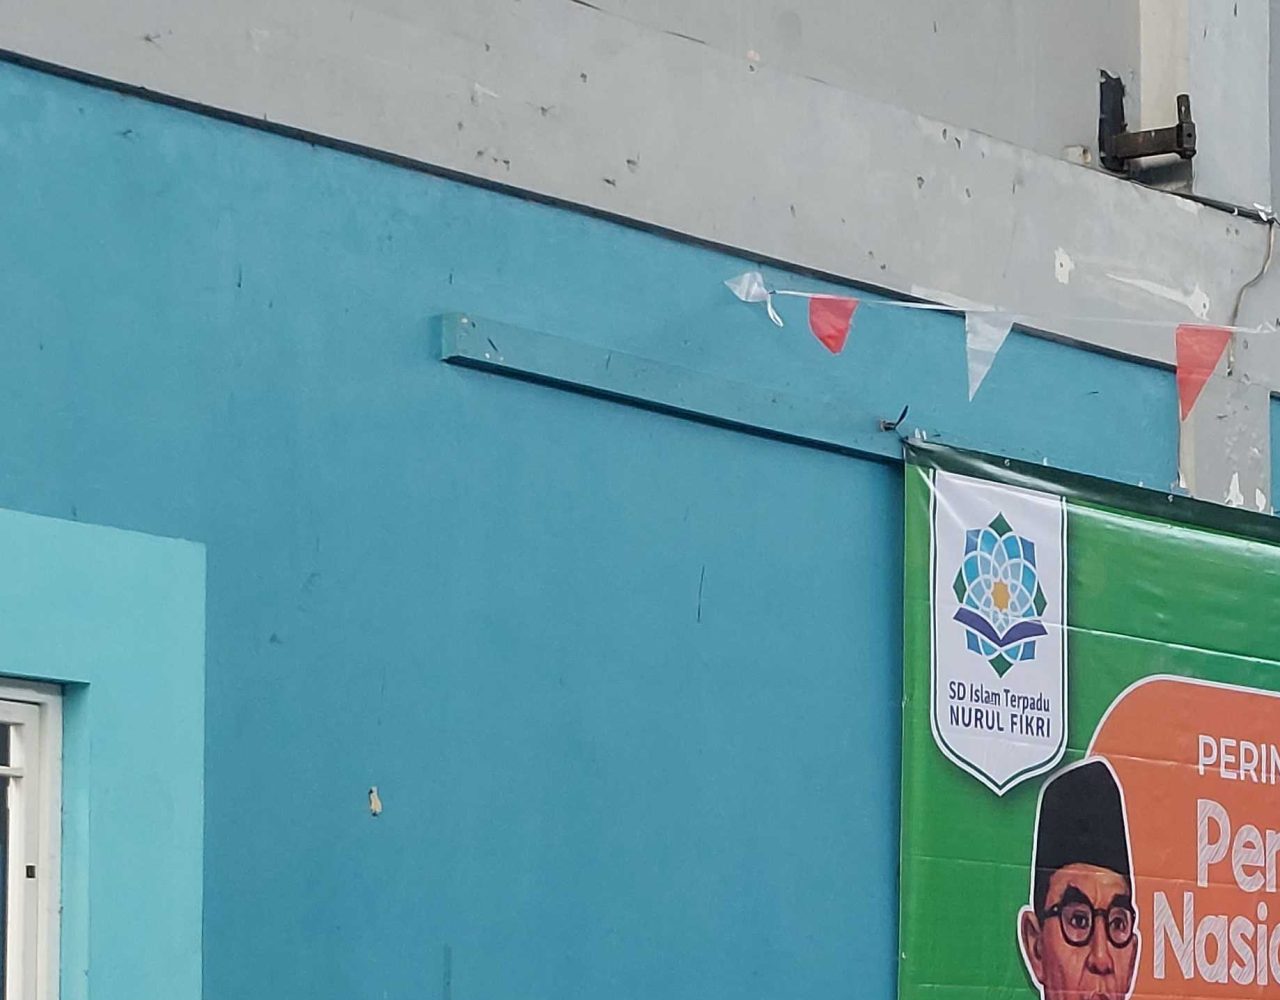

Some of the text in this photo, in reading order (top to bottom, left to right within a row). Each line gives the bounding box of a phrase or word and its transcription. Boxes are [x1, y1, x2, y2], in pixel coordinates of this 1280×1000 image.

[949, 681, 1050, 714] SD Islam Terpadu
[950, 705, 1050, 737] NURUL FIKRI
